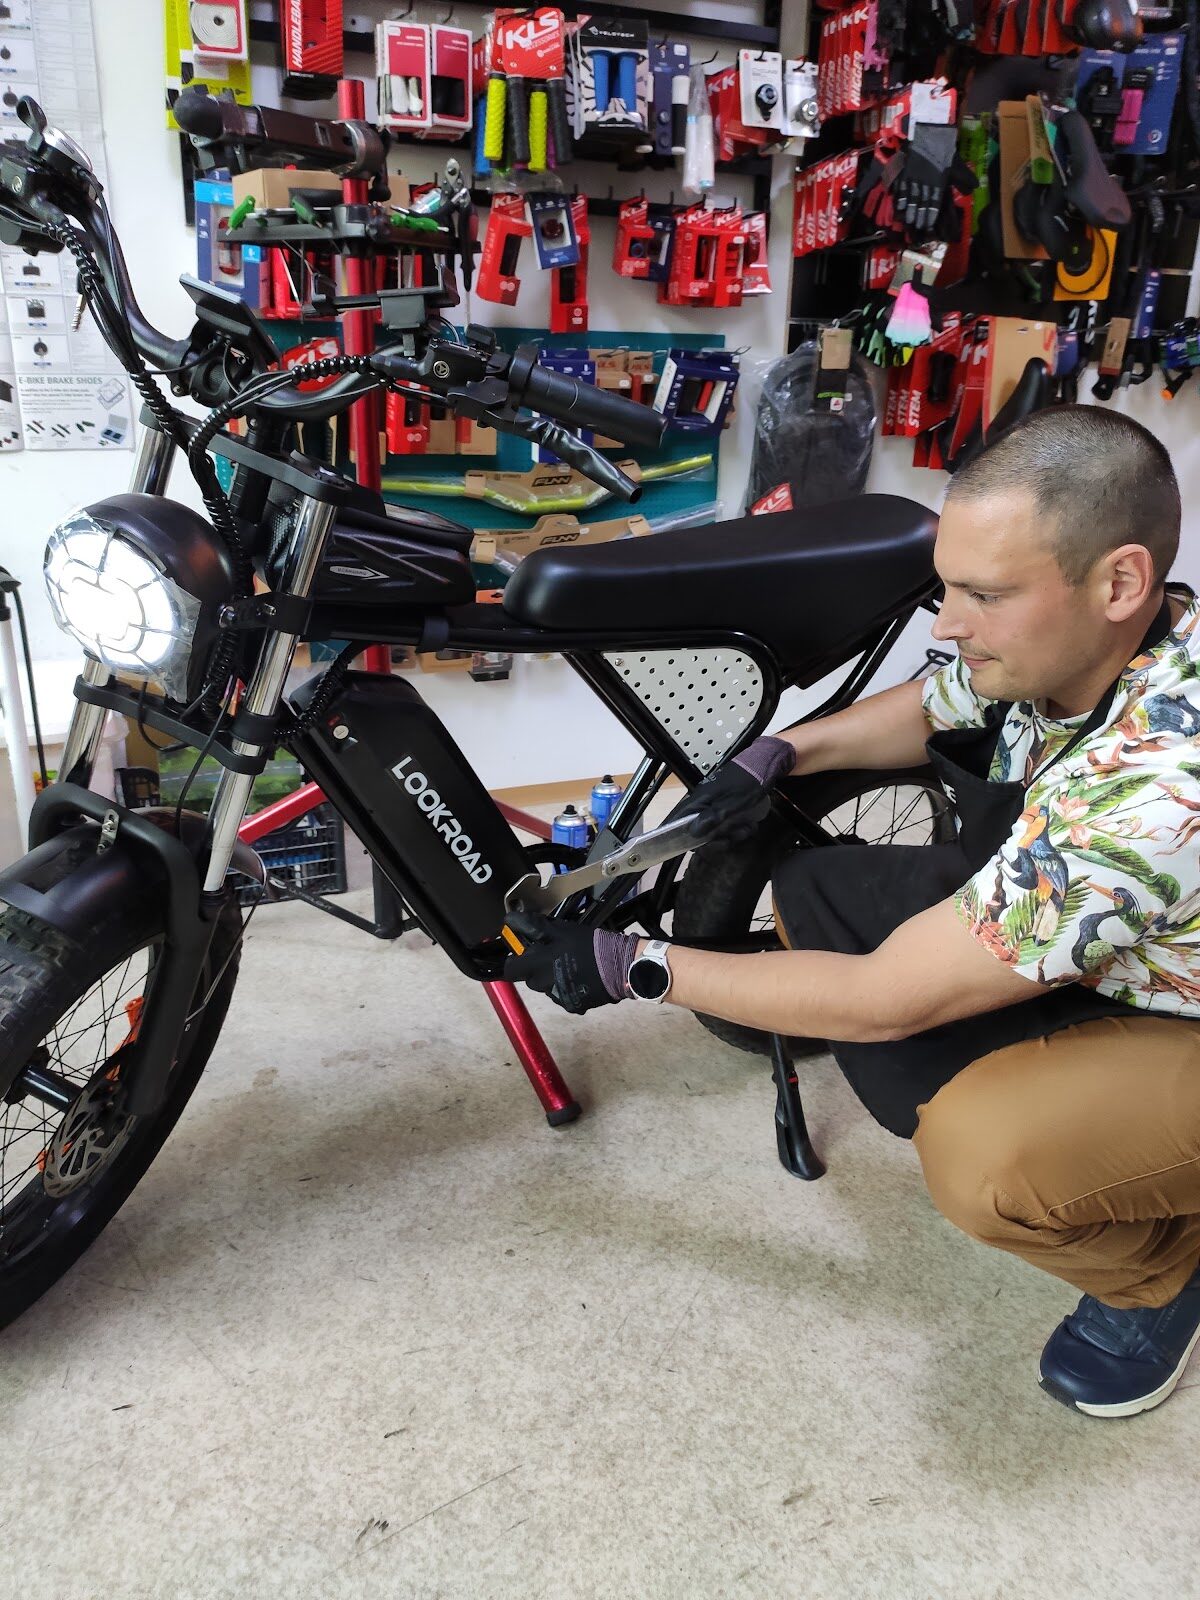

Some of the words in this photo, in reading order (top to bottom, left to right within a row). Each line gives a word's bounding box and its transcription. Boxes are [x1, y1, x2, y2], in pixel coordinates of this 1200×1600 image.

[505, 11, 559, 49] KLS
[18, 376, 45, 385] E-BIKE
[48, 377, 74, 385] BRAKE
[76, 377, 103, 385] SHOES
[908, 389, 922, 428] STEM
[391, 756, 493, 885] LOOKROAD
